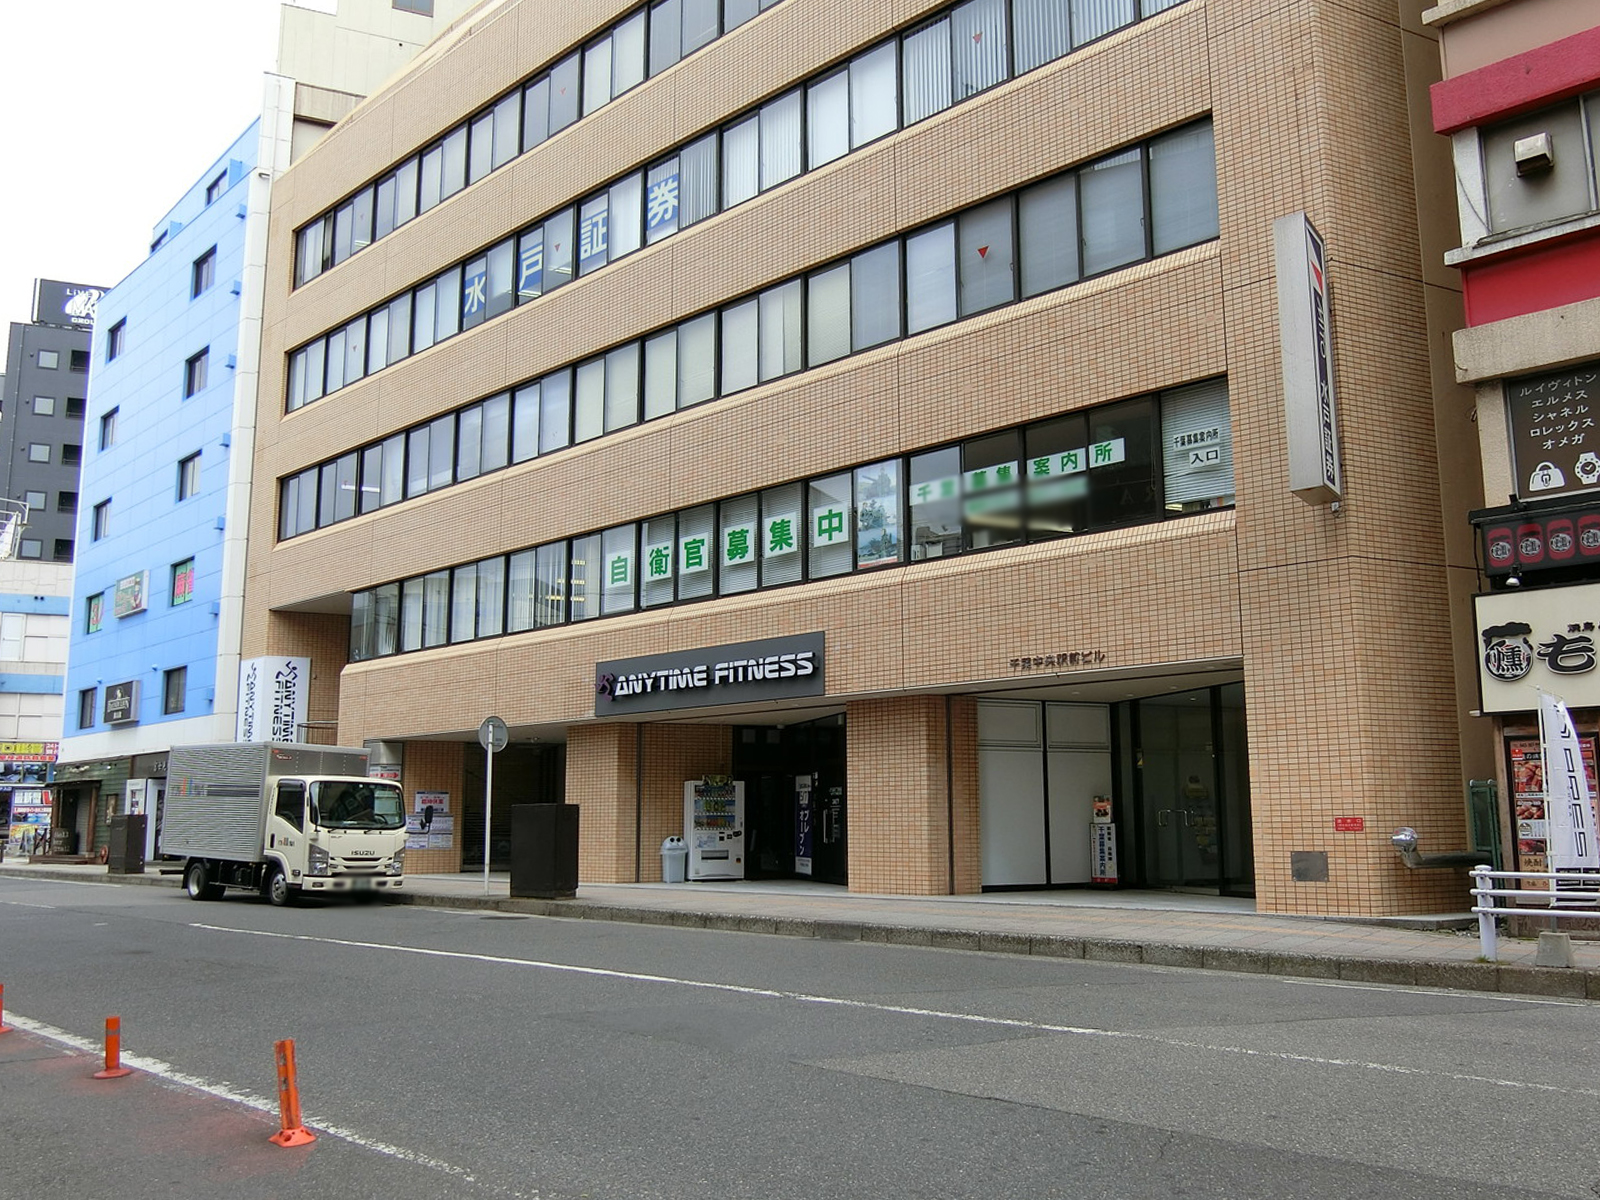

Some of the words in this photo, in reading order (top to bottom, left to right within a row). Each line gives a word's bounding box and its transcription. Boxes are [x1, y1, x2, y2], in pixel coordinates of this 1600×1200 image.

[464, 178, 679, 314] 水戸証券
[1520, 374, 1597, 397] ルイヴィトン
[1531, 389, 1588, 408] エルメス
[1532, 404, 1589, 423] シャネル
[1530, 418, 1595, 437] ロレックス
[1173, 428, 1218, 448] 千葉募集案内所
[1542, 433, 1585, 450] オメガ
[1190, 450, 1218, 465] 入口
[610, 508, 843, 585] 自衛官募集中
[1009, 650, 1105, 673] 千葉中央駅前ビル
[614, 664, 708, 696] ANYTIME
[714, 651, 815, 685] FITNESS
[350, 849, 375, 857] ISUZU
